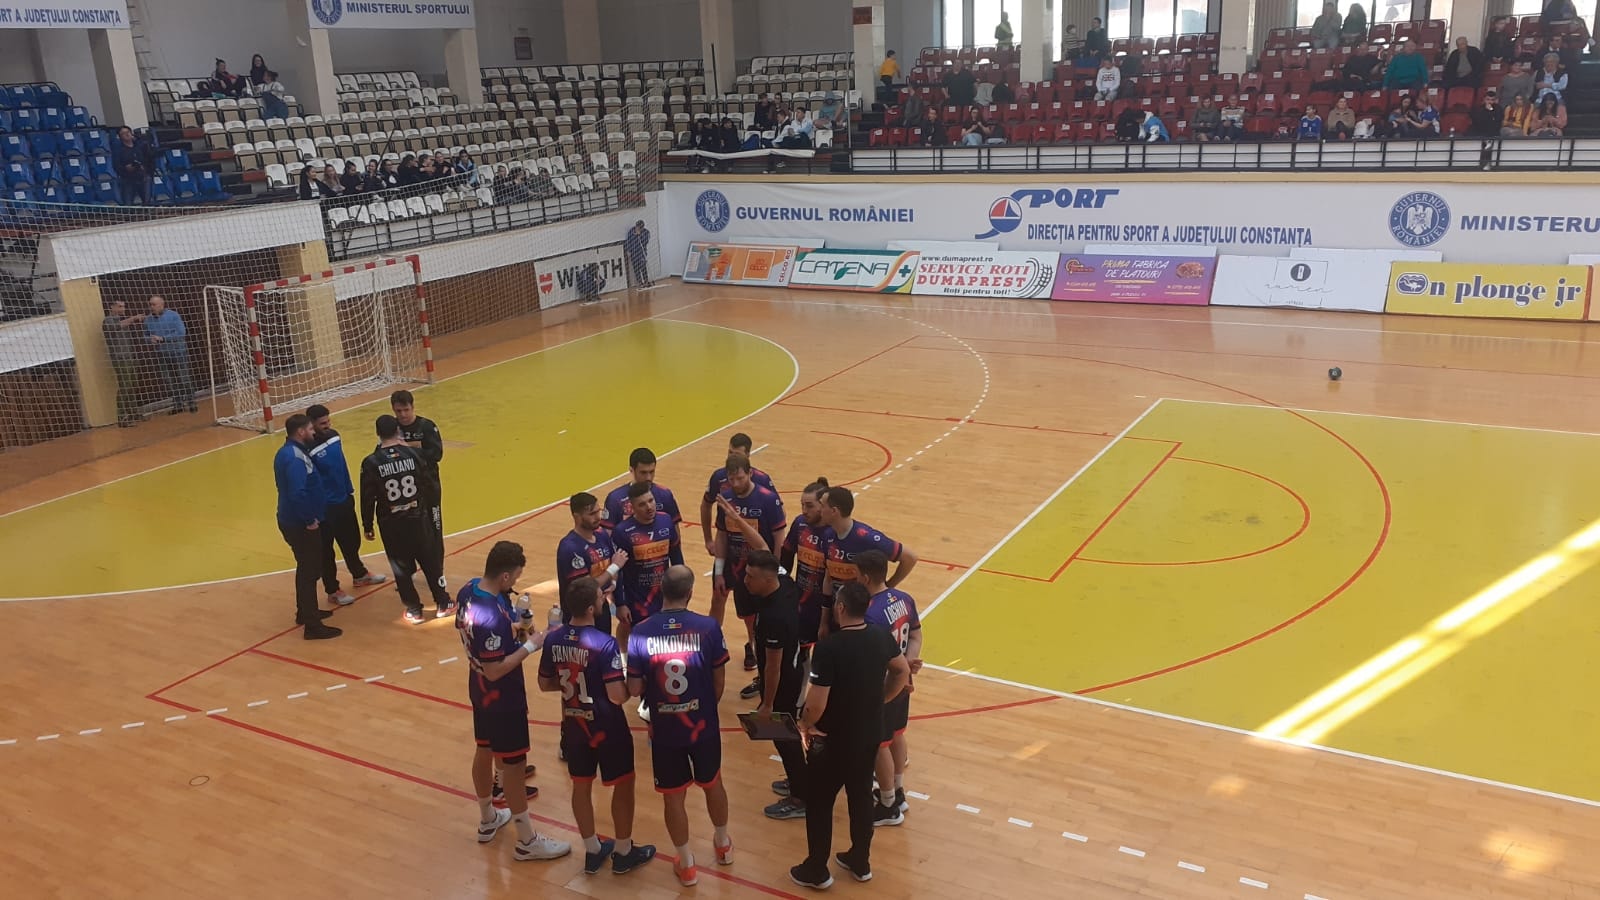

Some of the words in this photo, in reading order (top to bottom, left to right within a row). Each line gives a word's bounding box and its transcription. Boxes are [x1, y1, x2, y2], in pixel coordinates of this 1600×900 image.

[0, 8, 12, 22] RT
[15, 8, 22, 22] A
[346, 2, 412, 14] MINISTERUL
[415, 4, 470, 14] SPORTULUI
[1395, 193, 1446, 214] GUVERNUL
[735, 206, 824, 221] GUVERNUL
[829, 204, 914, 223] ROMÂNIEI
[1460, 215, 1600, 233] MINISTERU
[1078, 224, 1120, 241] PENTRU
[1122, 225, 1160, 242] SPORT
[1162, 225, 1170, 242] A
[921, 255, 994, 263] www.dumaprest.ro
[1101, 259, 1131, 269] PRIMA
[798, 260, 890, 277] CATENA
[918, 263, 985, 274] SERVICE
[990, 264, 1030, 275] ROTI
[1105, 269, 1119, 278] DE
[916, 275, 1027, 287] DUMAPREST
[1453, 275, 1546, 306] plonge
[1554, 278, 1582, 307] jr
[385, 475, 418, 502] 88
[647, 531, 655, 541] 7
[646, 633, 701, 656] CHIKOVANI
[663, 658, 689, 696] 8
[558, 668, 594, 704] 31
